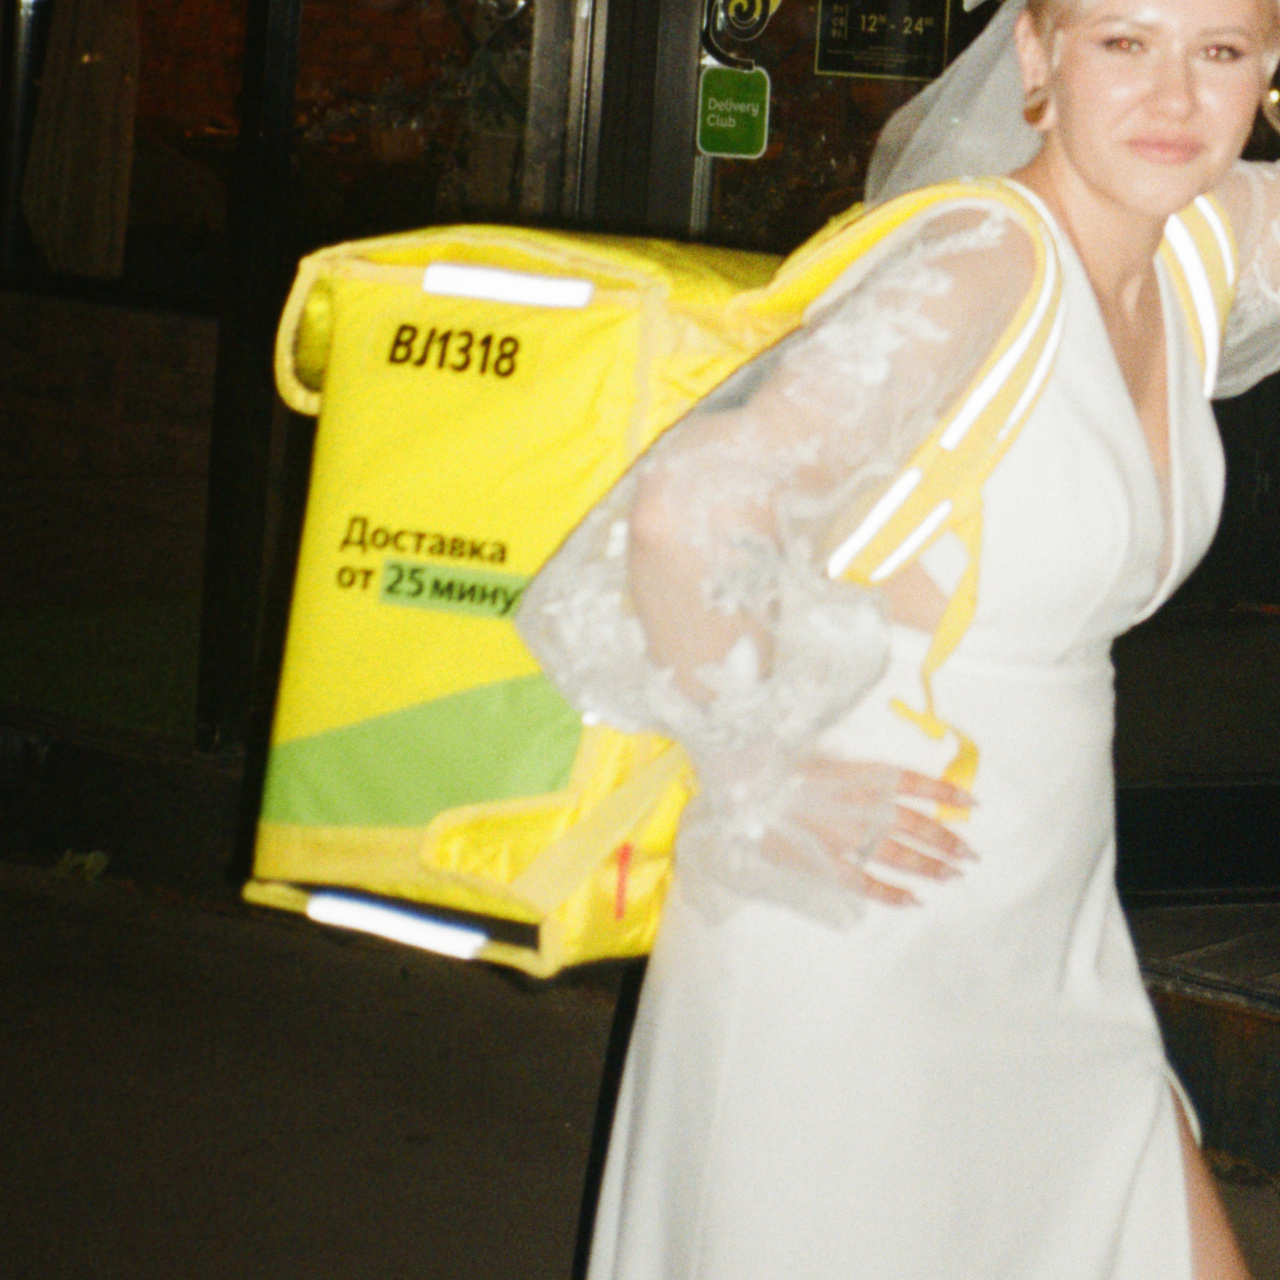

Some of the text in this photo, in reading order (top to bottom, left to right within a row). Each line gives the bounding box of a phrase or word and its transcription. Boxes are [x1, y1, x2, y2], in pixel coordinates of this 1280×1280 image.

[706, 114, 737, 128] Club
[707, 97, 760, 117] Delivery
[388, 323, 520, 378] BJ1318
[338, 516, 508, 565] Доставка
[335, 566, 375, 590] от
[386, 564, 426, 597] 25
